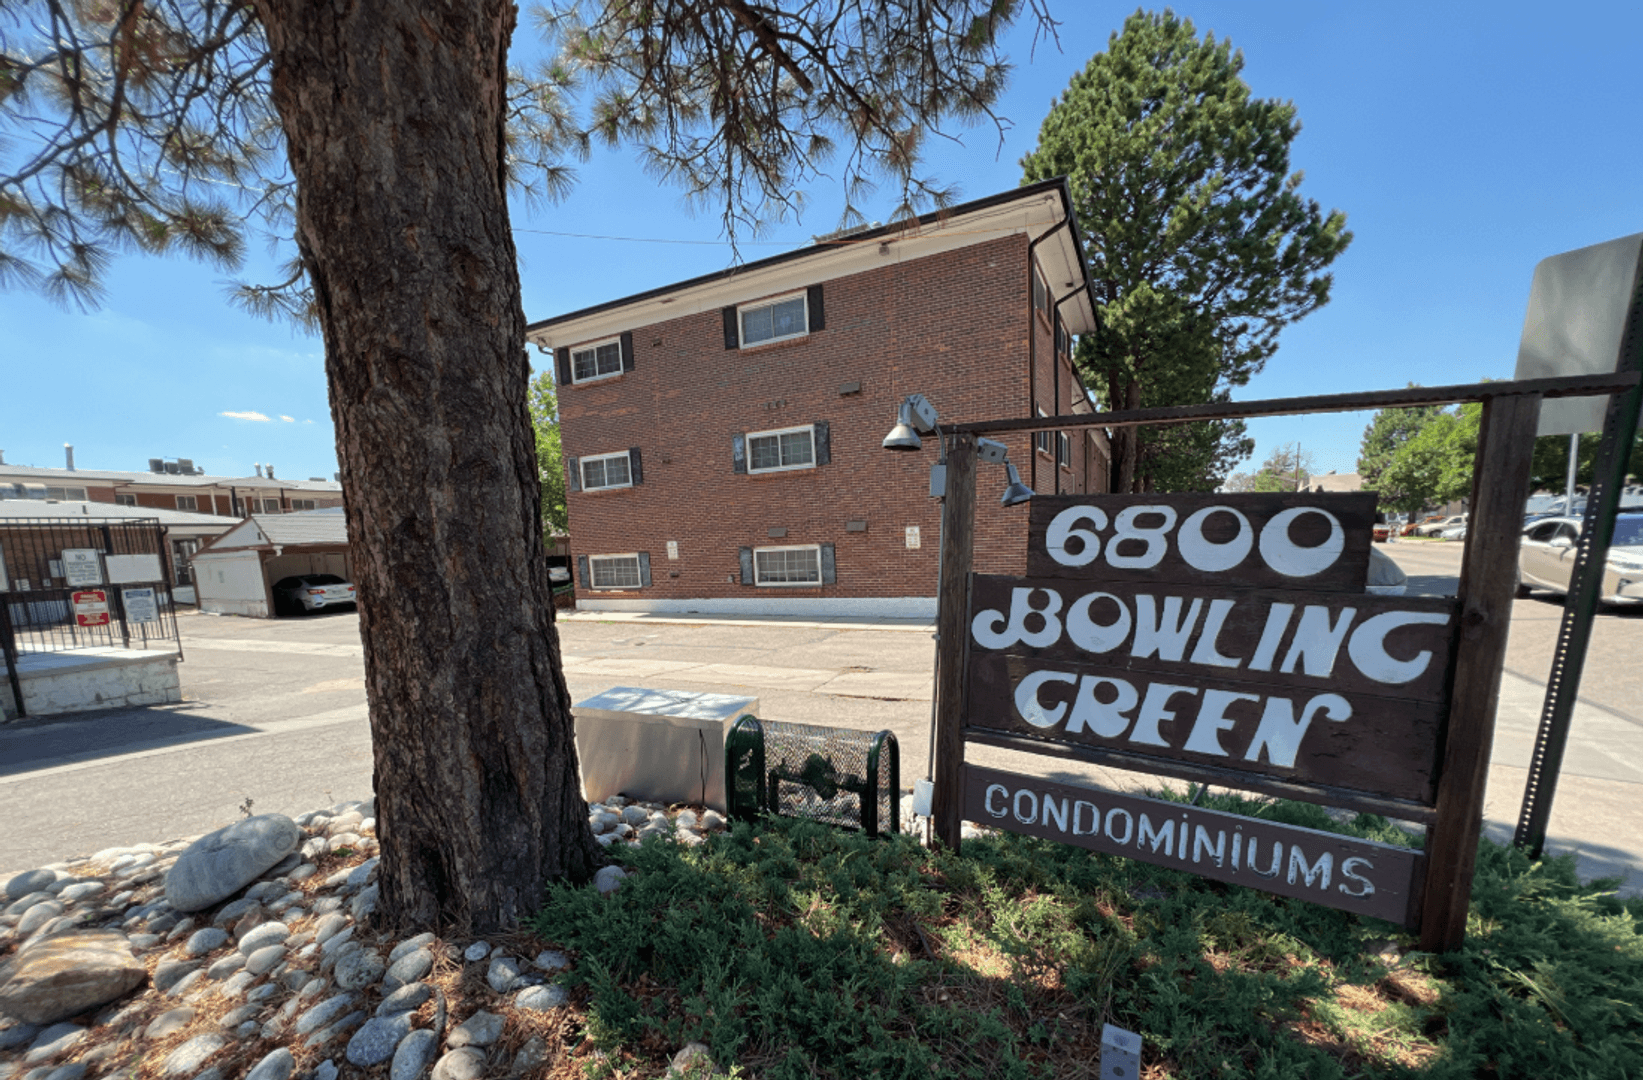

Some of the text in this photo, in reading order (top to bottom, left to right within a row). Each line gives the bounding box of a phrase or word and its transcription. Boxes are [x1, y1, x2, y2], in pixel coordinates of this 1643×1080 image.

[1045, 504, 1345, 577] 6800
[971, 586, 1451, 684] BOWLING
[1014, 669, 1353, 769] GREEN
